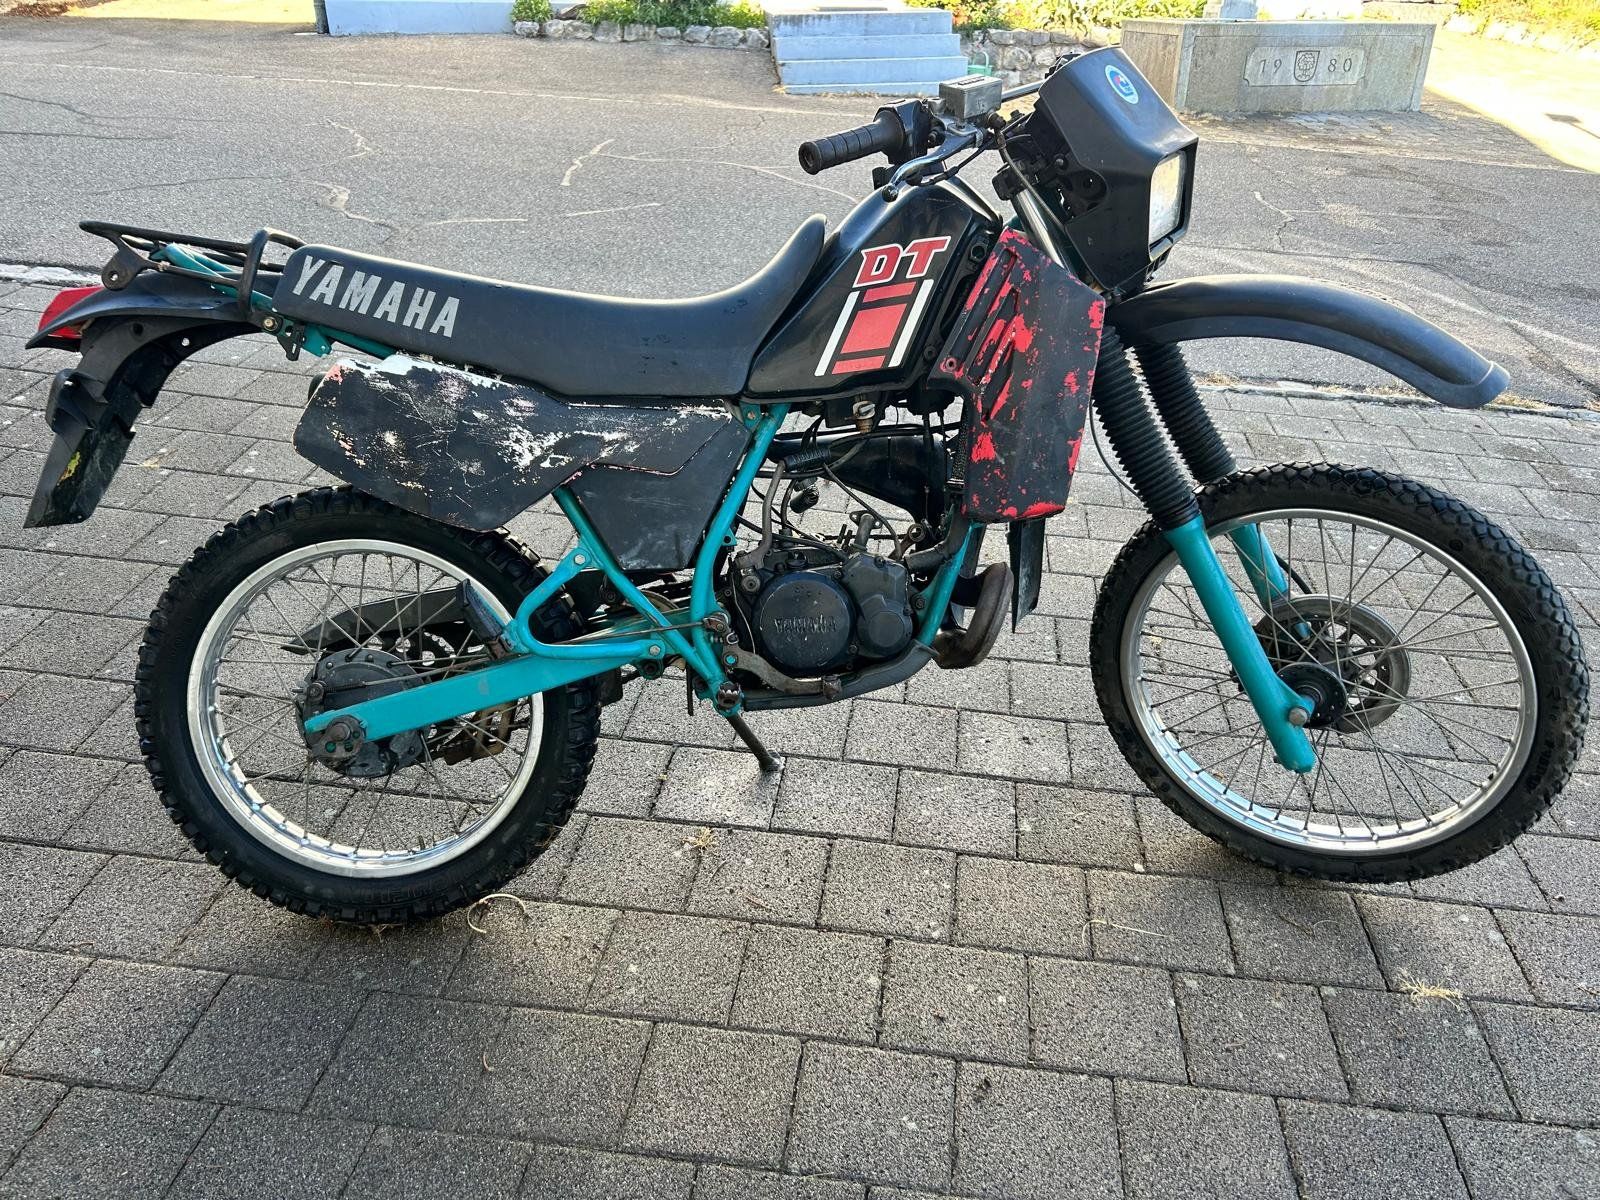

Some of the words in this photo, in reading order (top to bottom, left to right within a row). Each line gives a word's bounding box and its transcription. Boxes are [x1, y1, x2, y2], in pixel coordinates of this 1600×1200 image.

[1259, 58, 1282, 74] 19
[1327, 58, 1352, 73] 80
[852, 235, 952, 288] DT
[292, 255, 460, 338] YAMAHA
